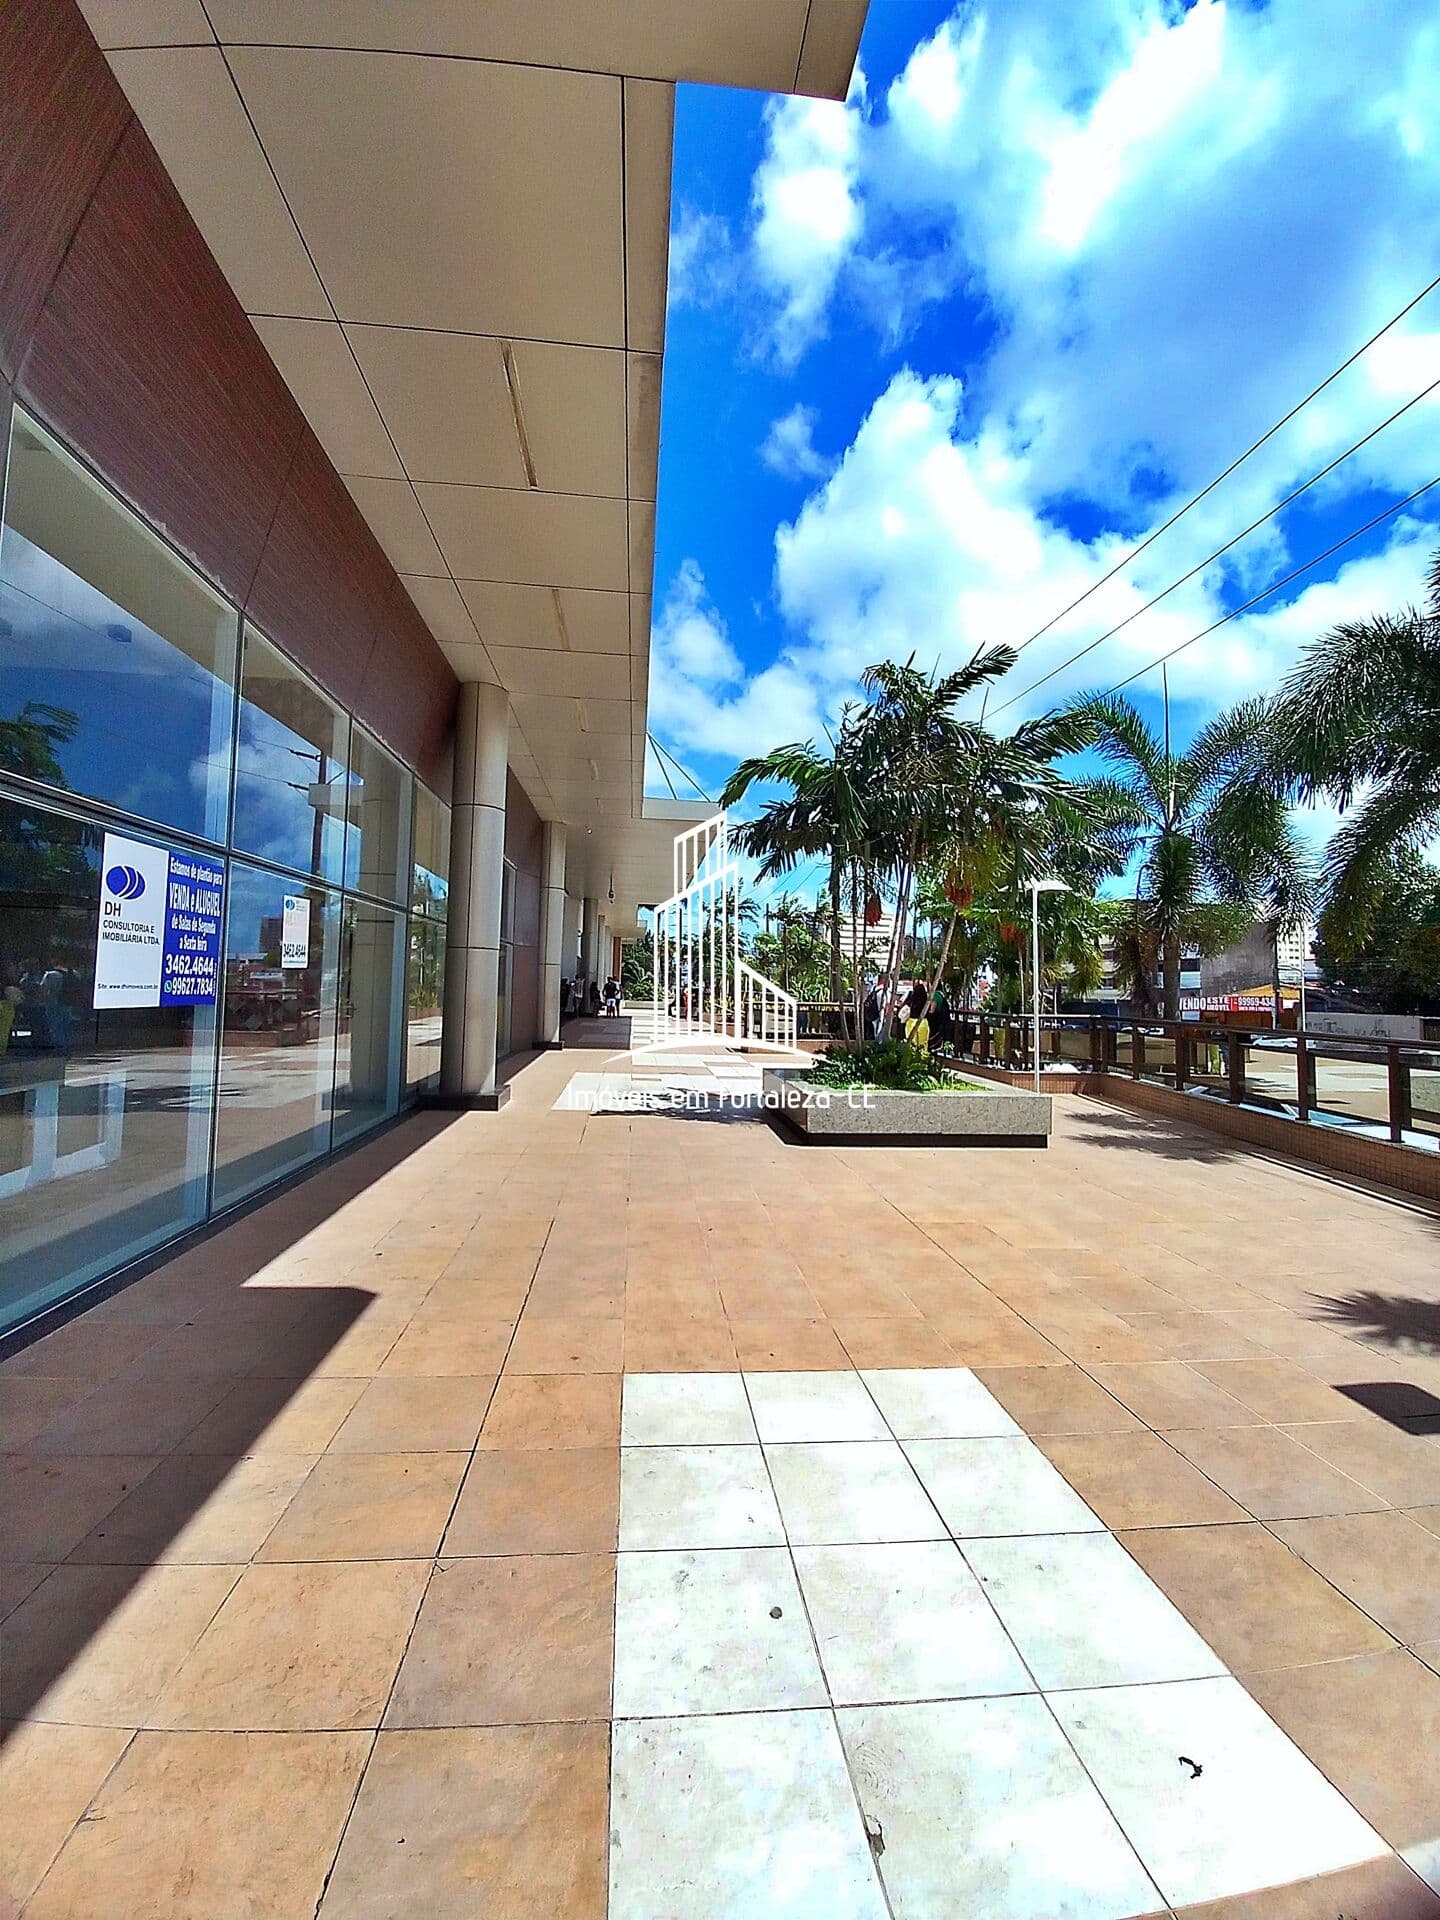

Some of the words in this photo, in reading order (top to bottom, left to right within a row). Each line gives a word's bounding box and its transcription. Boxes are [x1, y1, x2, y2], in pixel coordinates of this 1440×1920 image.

[104, 901, 121, 917] DH
[170, 882, 190, 911] VENDA
[195, 888, 220, 917] ALUGUEL
[103, 919, 150, 934] CONSULTORIA
[150, 926, 155, 934] E
[165, 953, 214, 976] 3462.4644
[172, 976, 213, 996] 99627.7834
